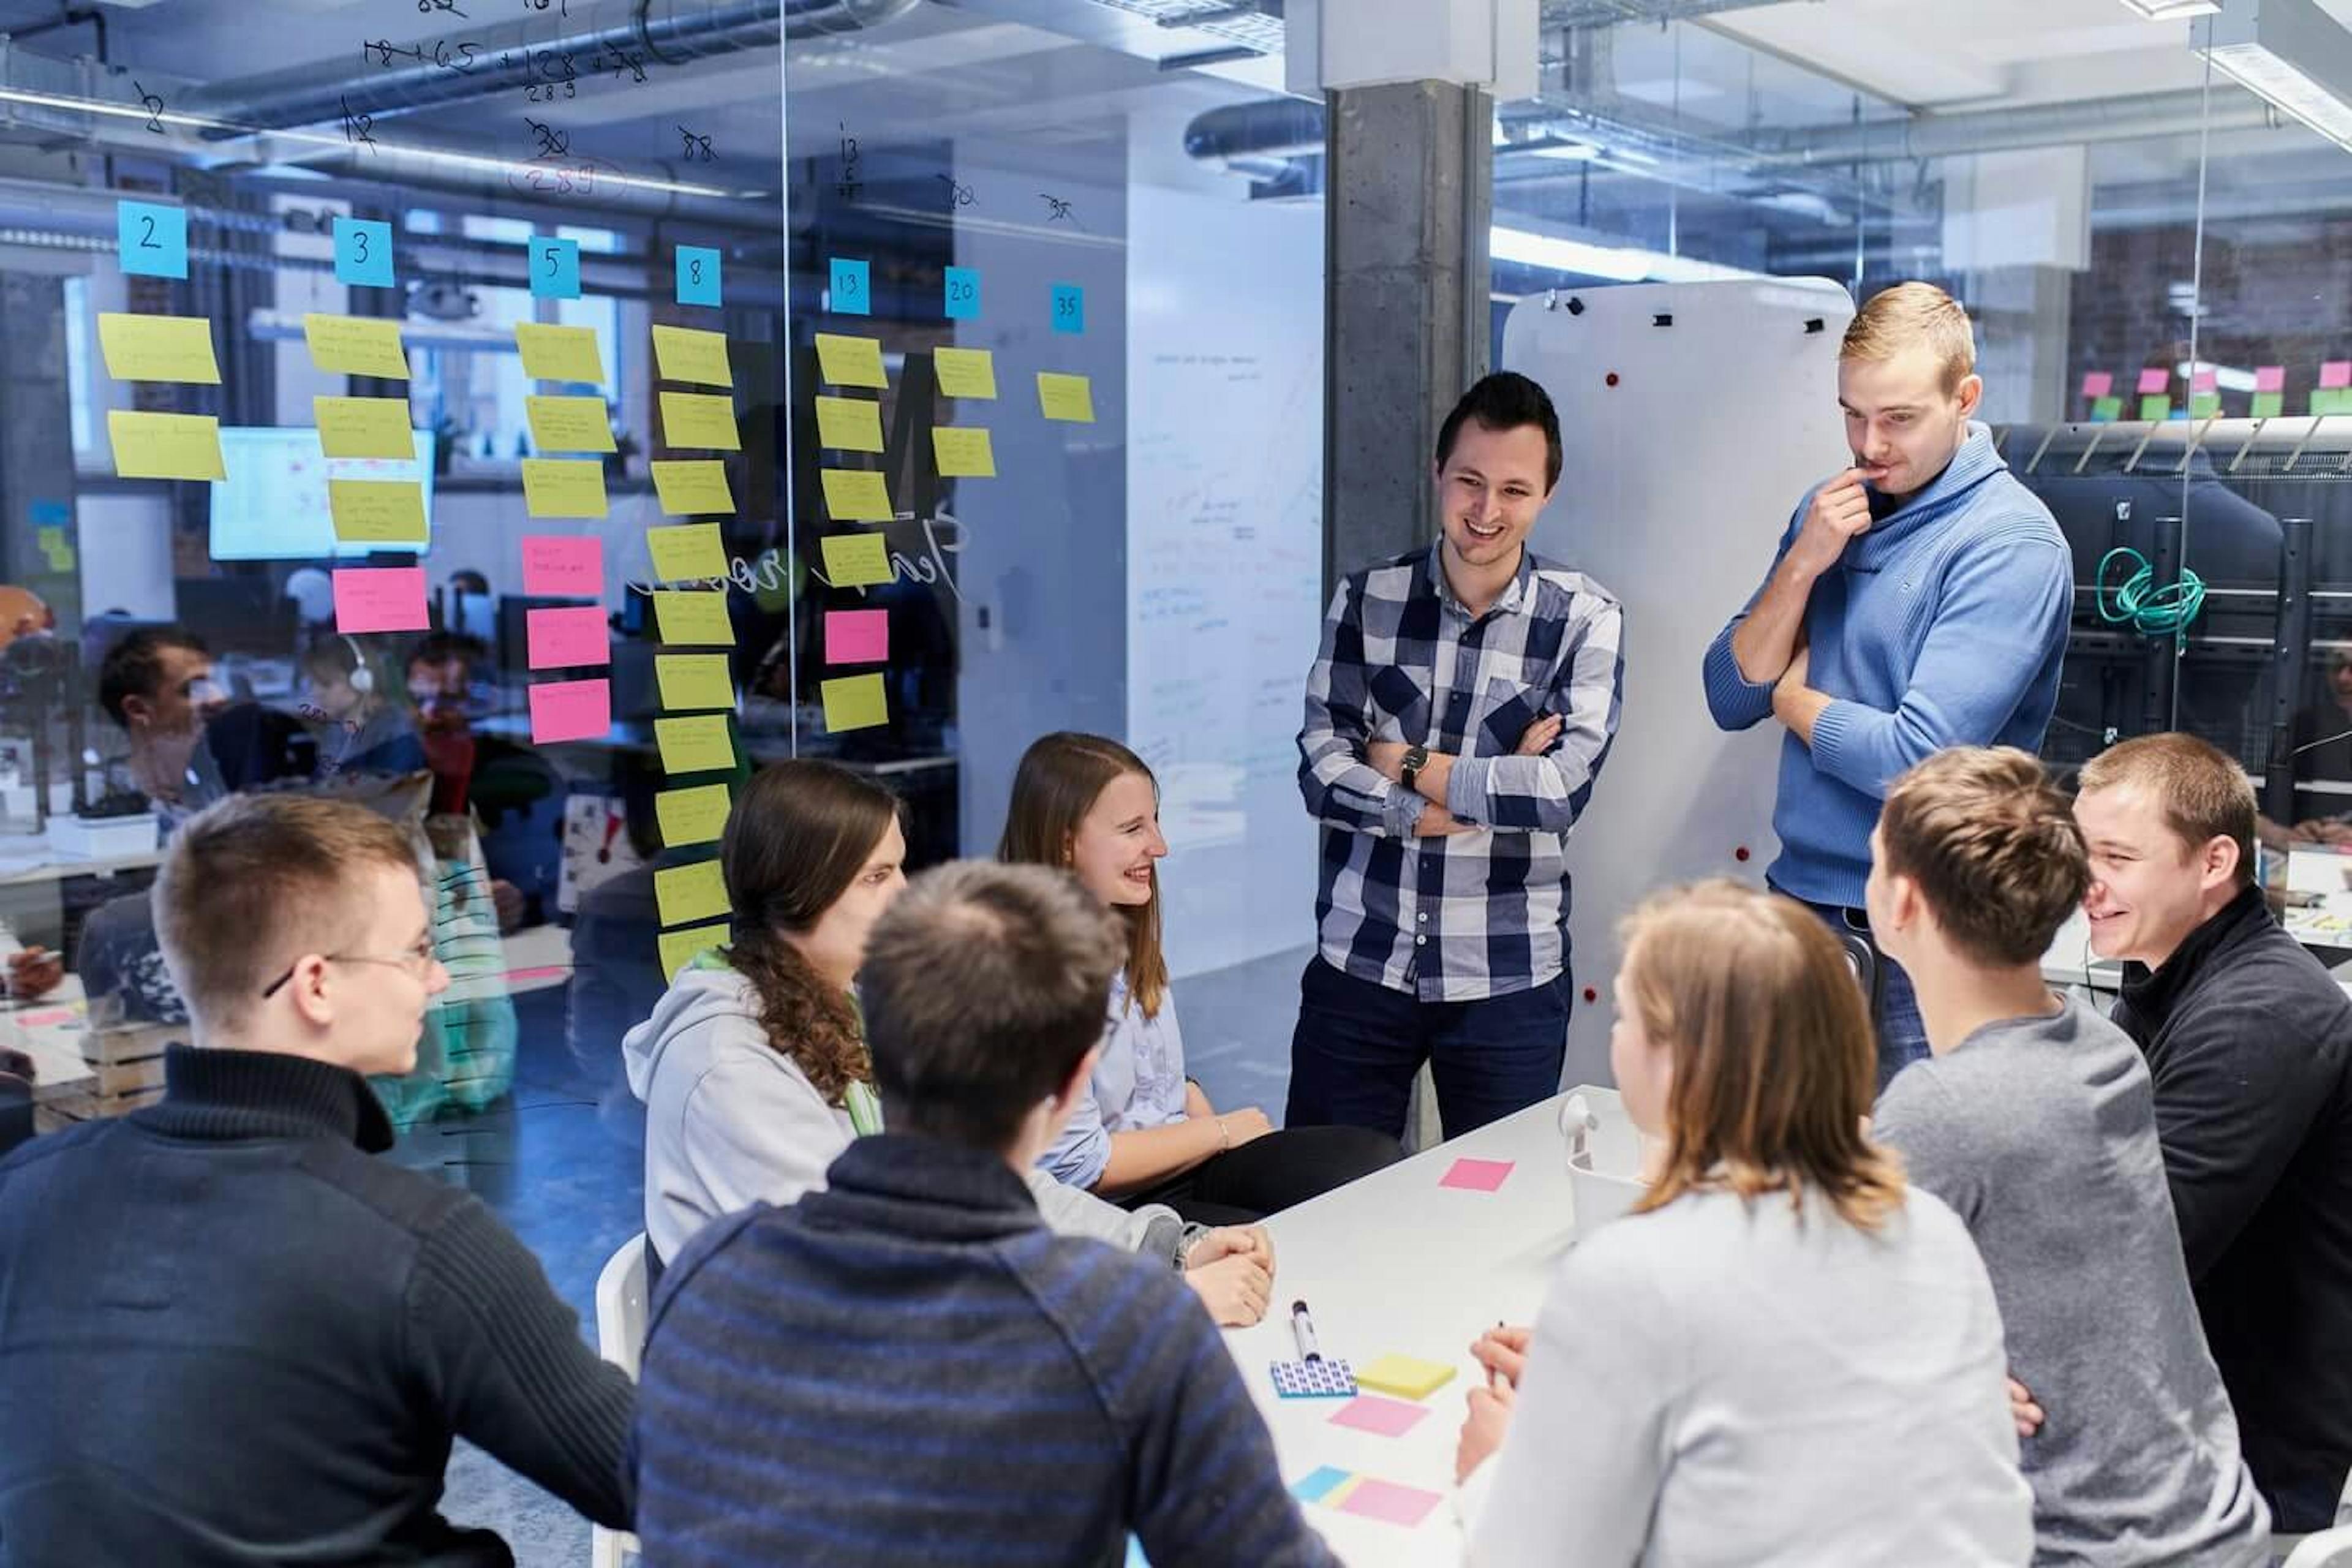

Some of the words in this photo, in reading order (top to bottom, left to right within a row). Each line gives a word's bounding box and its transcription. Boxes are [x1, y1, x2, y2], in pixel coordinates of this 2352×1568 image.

[526, 50, 575, 82] 128
[524, 83, 576, 102] 289
[141, 216, 162, 249] 2
[353, 232, 369, 264] 3
[546, 248, 561, 277] 5
[690, 258, 701, 285] 8
[839, 273, 858, 295] 13
[951, 280, 974, 301] 20
[1058, 296, 1076, 315] 35
